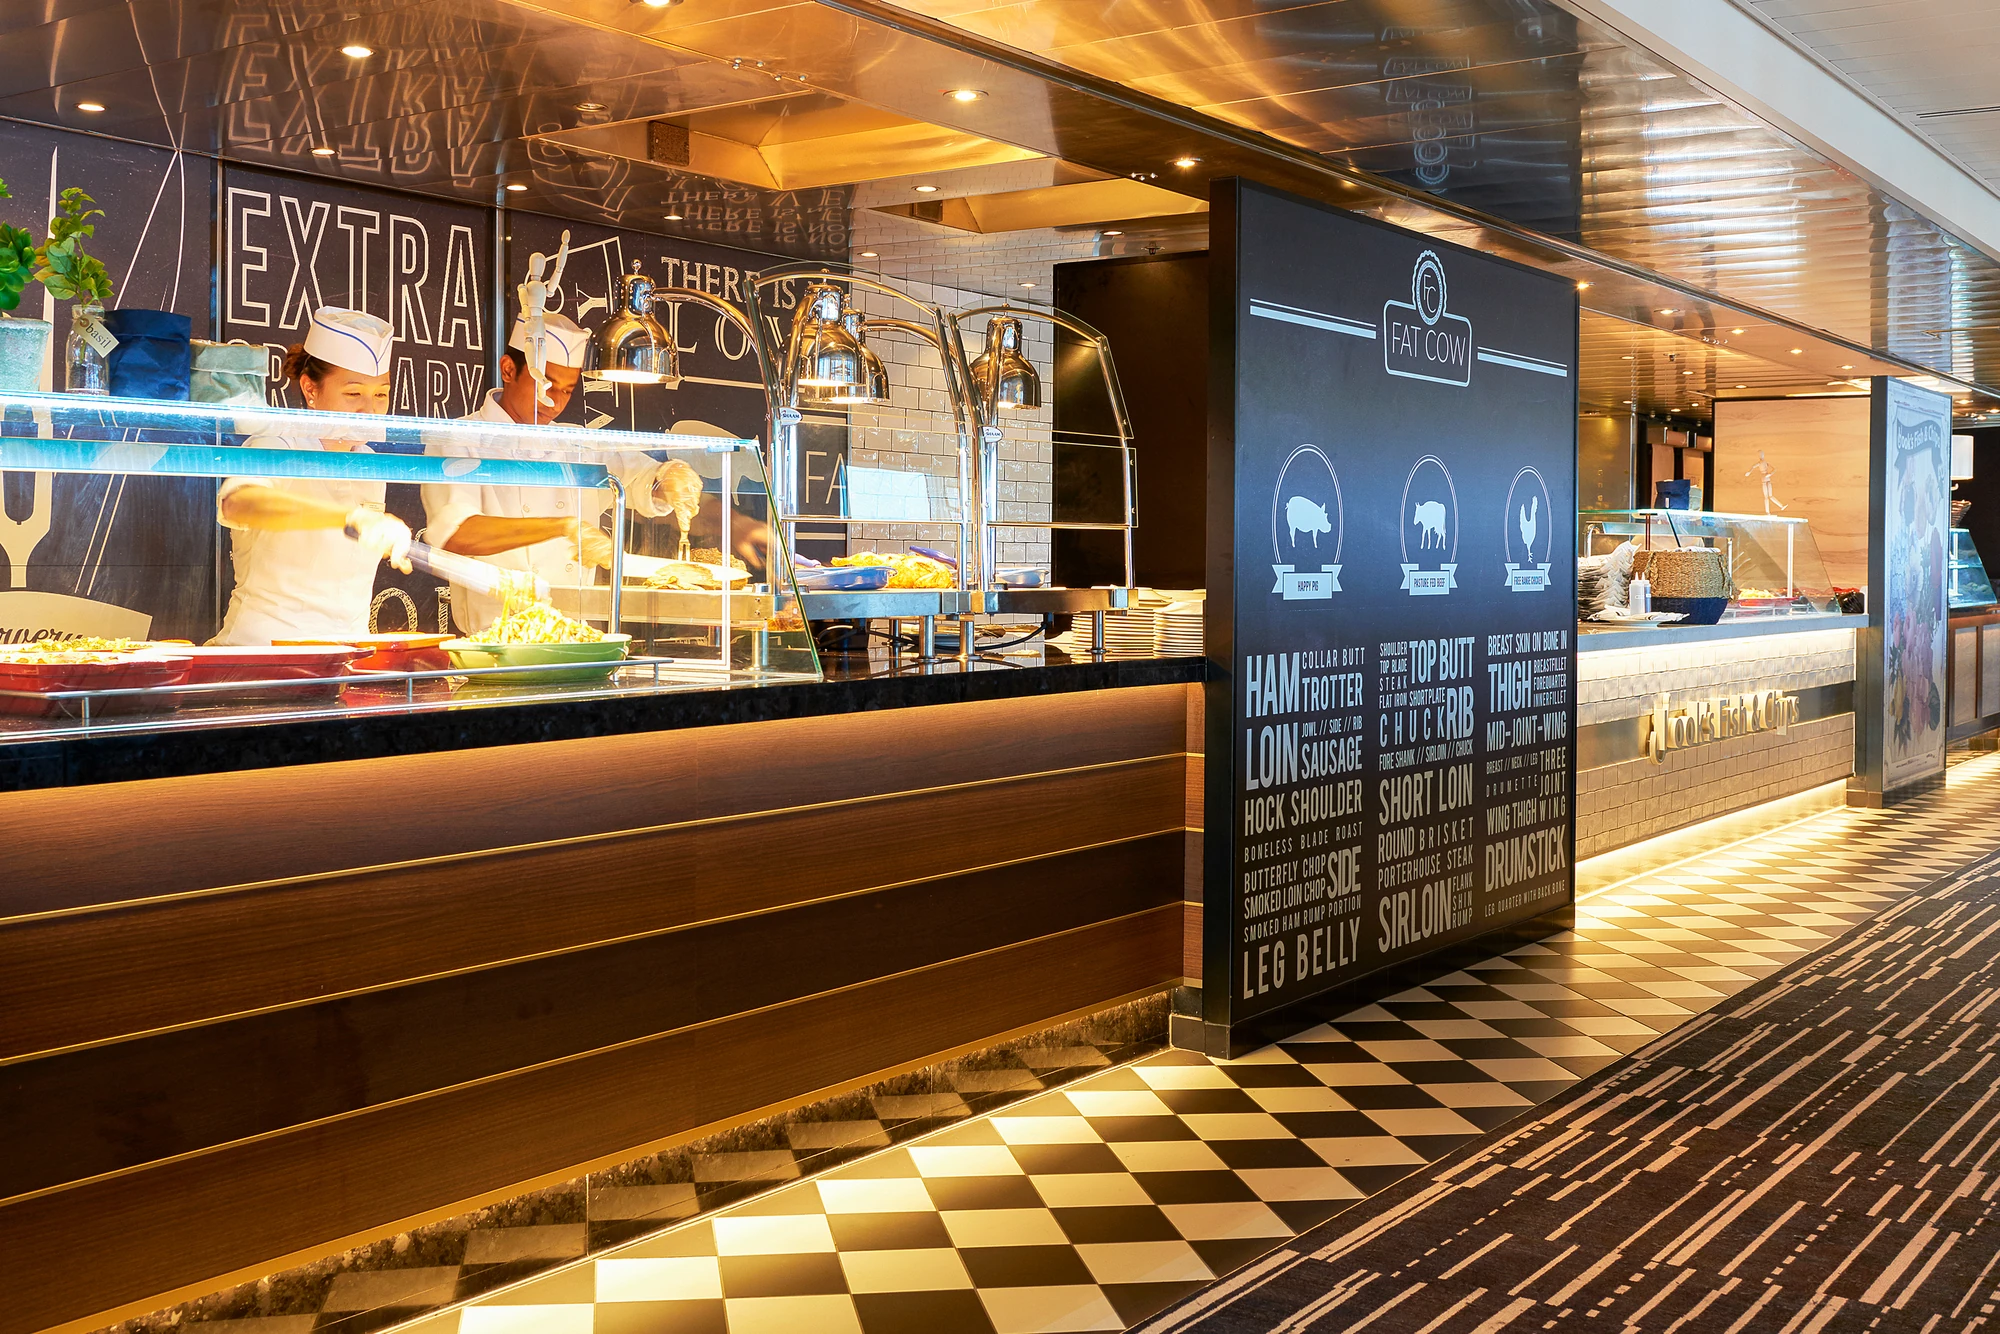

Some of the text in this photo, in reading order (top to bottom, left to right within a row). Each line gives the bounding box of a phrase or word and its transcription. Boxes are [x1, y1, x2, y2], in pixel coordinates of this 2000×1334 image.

[227, 186, 483, 351] EXTRA
[773, 276, 797, 310] IS
[85, 323, 112, 349] basil
[1393, 322, 1466, 366] FAT COW
[1302, 647, 1365, 670] COLLAR BUTT
[1380, 641, 1408, 657] SHOULDER
[1409, 636, 1475, 684] TOP BUTT
[1488, 630, 1567, 656] BREAST SKIN ON BONE IN
[1246, 652, 1300, 718] HAM
[1379, 675, 1407, 692] STEAK
[1380, 658, 1408, 674] TOP BLADE
[1488, 660, 1532, 713] THIGH
[1302, 672, 1363, 712] TROTTER
[1379, 693, 1392, 709] FLAT
[1394, 692, 1407, 707] IRON
[1446, 685, 1475, 741] RIB
[1301, 721, 1317, 738] JOWL
[1329, 718, 1342, 734] SIDE
[1353, 715, 1363, 731] RIB
[1380, 705, 1445, 748] CHUCK
[1711, 694, 1748, 739] Fish
[1759, 690, 1800, 736] Chips
[1246, 722, 1299, 791] LOIN
[1301, 735, 1363, 780] SAUSAGE
[1379, 753, 1394, 771] FORE
[1395, 748, 1415, 768] SHANK
[1425, 743, 1447, 763] SIRLOIN
[1455, 739, 1474, 757] CHUCK
[1486, 759, 1503, 775] BREAST
[1511, 755, 1522, 770] NECK
[1530, 752, 1538, 766] LEG
[1540, 746, 1566, 772] THREE
[1379, 762, 1473, 826] SHORT LOIN
[1540, 771, 1566, 797] JOINT
[1245, 779, 1362, 837] HOCK SHOULDER
[1487, 795, 1566, 836] WING THIGH WING
[1244, 821, 1363, 863] BONELESS BLADE ROAST
[1378, 816, 1474, 864] ROUND BRISKET
[1485, 824, 1566, 893] DRUMSTICK
[1244, 854, 1326, 894] BUTTERFLY CHOP
[1327, 845, 1361, 899] SIDE
[1378, 844, 1473, 891] PORTERHOUSE STEAK
[1452, 871, 1473, 892] FLANK
[1244, 877, 1326, 920] SMOKED LOIN CHOP
[1244, 894, 1361, 943] SMOKED HAM RUMP PORTION
[1378, 877, 1452, 953] SIRLOIN
[1452, 890, 1473, 911] SHIN
[1452, 907, 1473, 929] RUMP
[1484, 879, 1565, 918] LEG QUARTER WITH BACK BONE
[1243, 916, 1360, 1000] LEG BELLY
